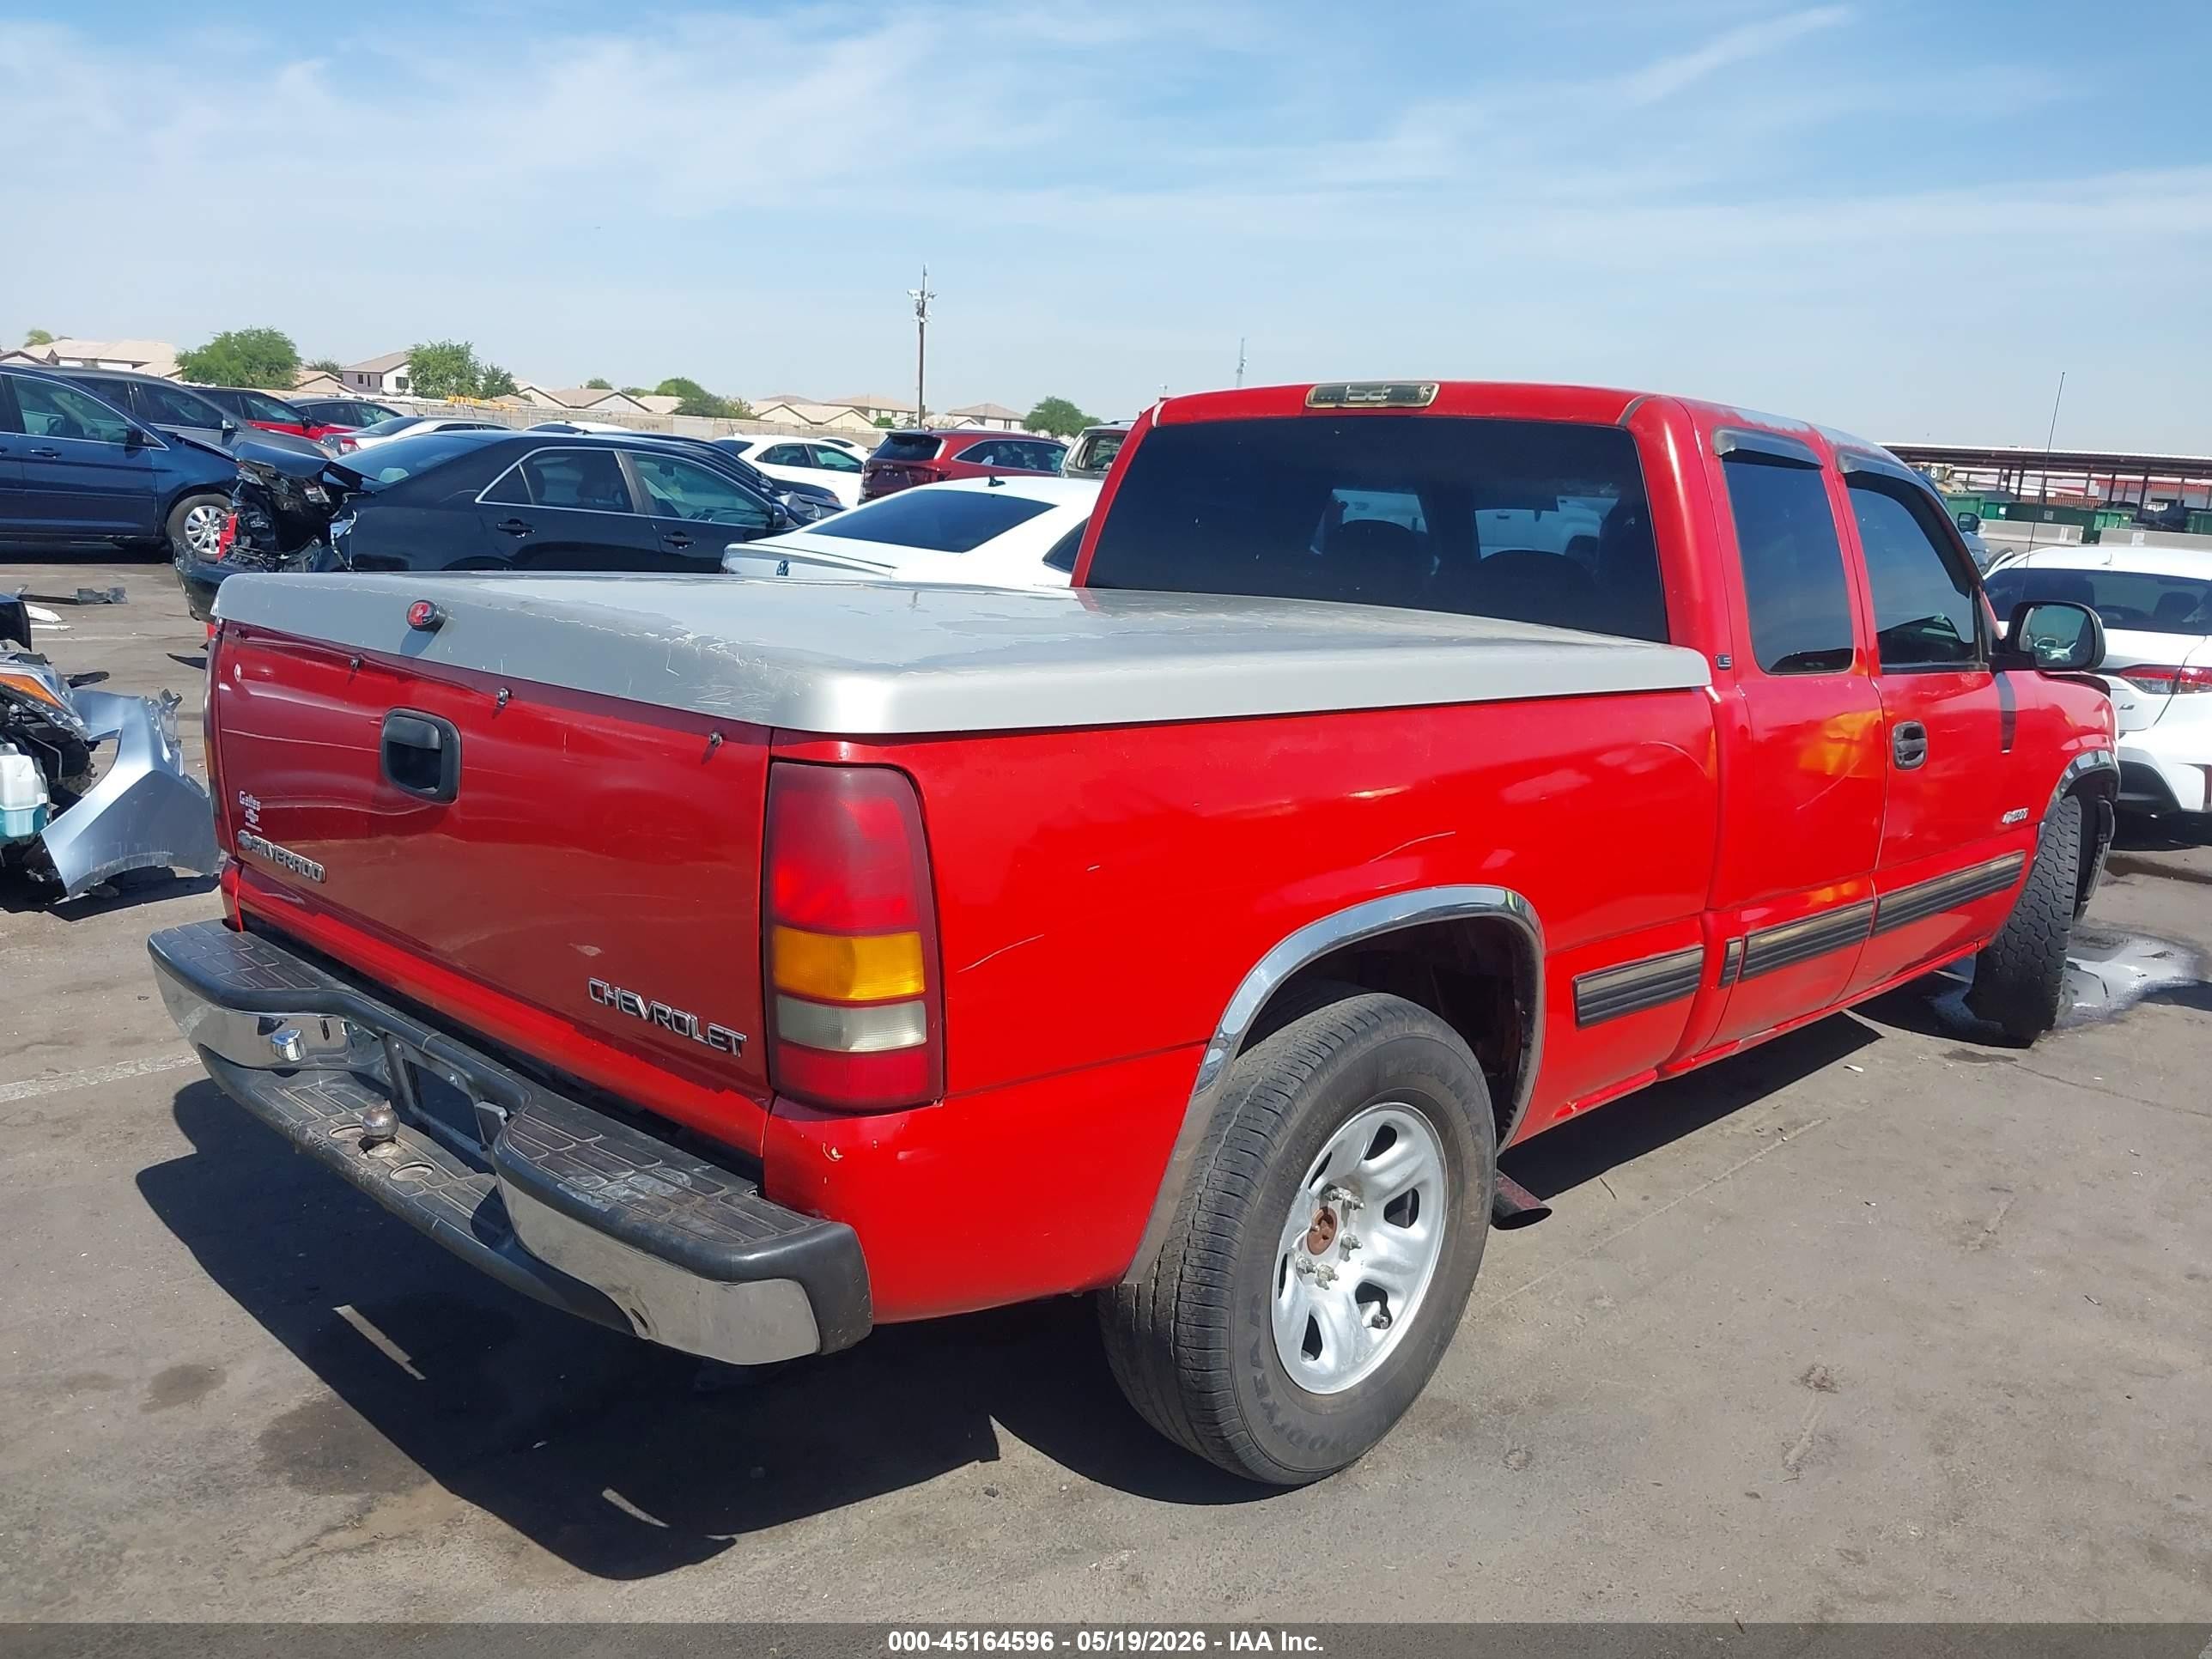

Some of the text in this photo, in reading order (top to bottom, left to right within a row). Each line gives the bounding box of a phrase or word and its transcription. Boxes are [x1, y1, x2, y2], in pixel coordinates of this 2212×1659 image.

[1929, 466, 1938, 478] 8
[251, 834, 325, 883] SILVERADO
[587, 976, 748, 1058] CHEVROLET
